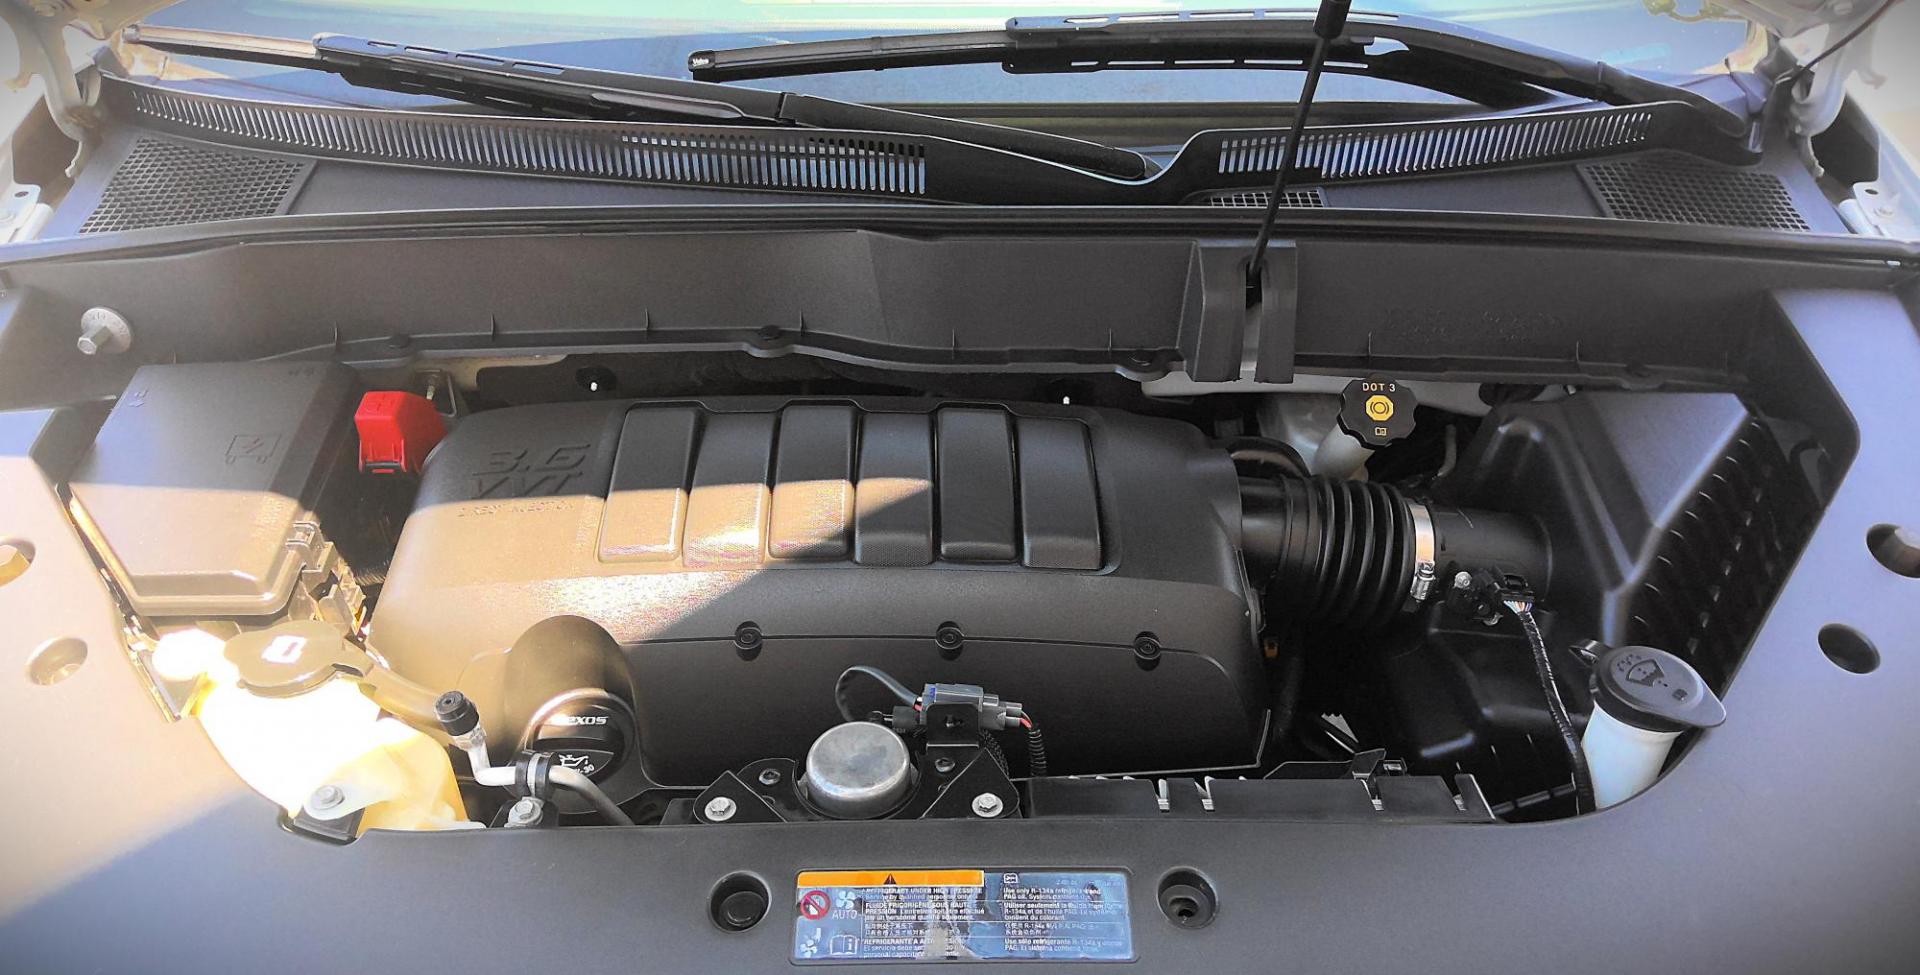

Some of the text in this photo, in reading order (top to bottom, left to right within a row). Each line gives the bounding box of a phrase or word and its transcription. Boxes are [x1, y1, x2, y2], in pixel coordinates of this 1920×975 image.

[1362, 382, 1396, 392] DOT 3
[472, 443, 591, 477] 3.6
[832, 910, 858, 919] AUTO
